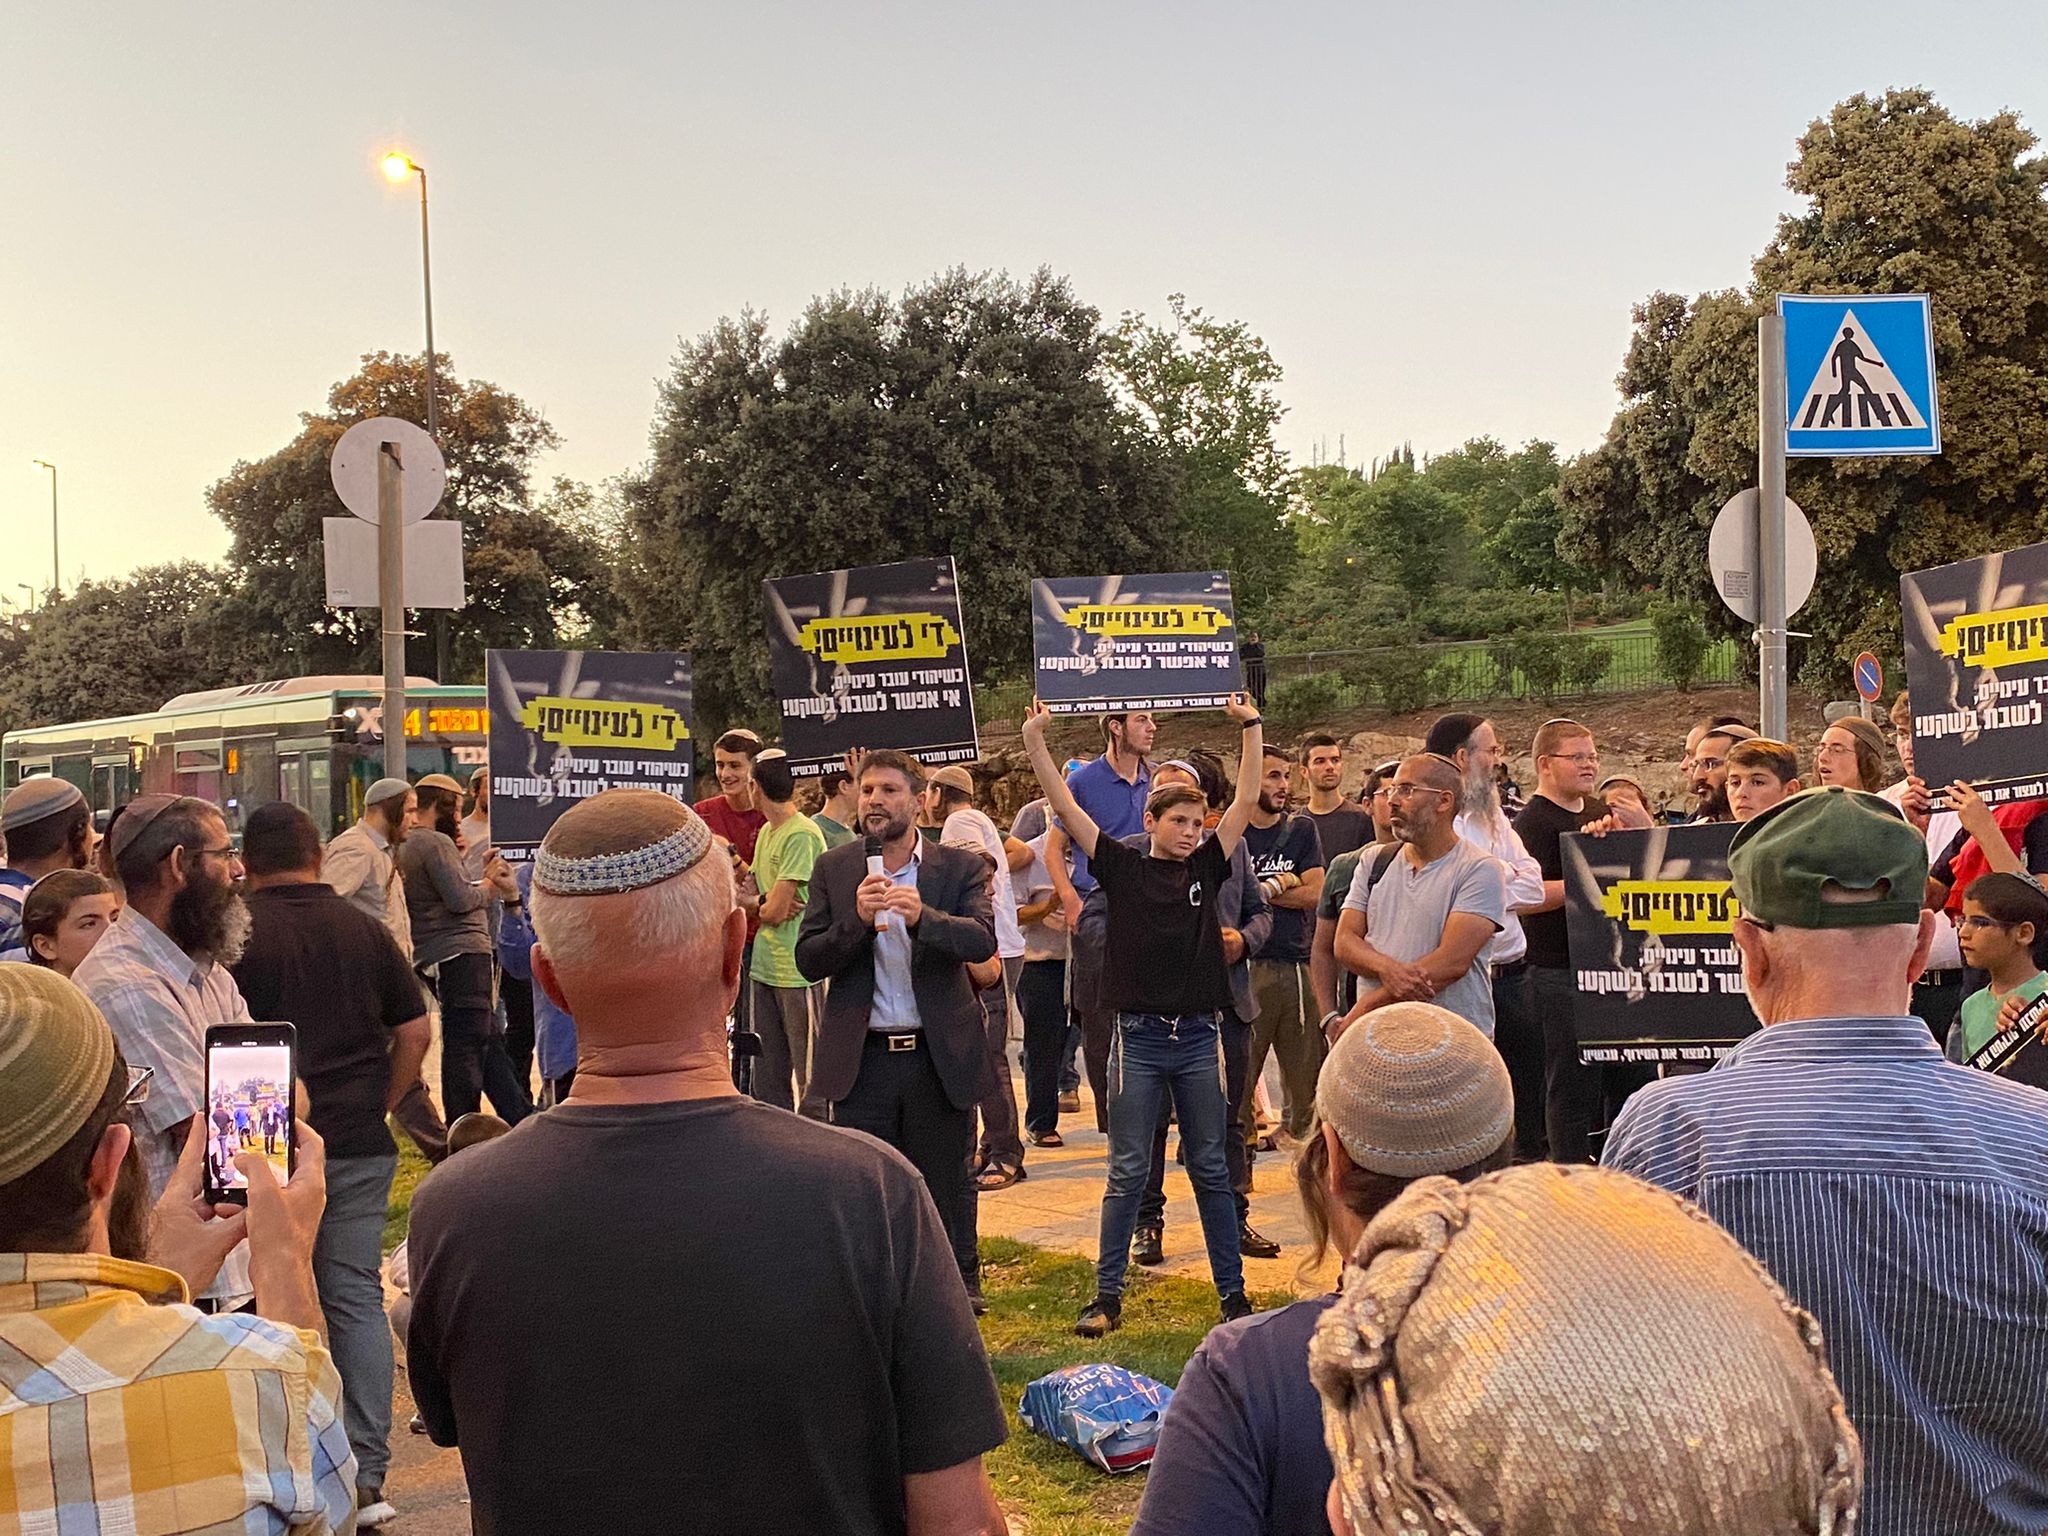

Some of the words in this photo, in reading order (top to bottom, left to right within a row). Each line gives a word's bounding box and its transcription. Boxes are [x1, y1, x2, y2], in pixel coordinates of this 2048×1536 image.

[1081, 608, 1184, 628] לעינויים!
[1192, 611, 1216, 628] די
[814, 620, 913, 654] לעינויים!
[921, 622, 944, 647] די
[1144, 642, 1177, 653] עובר
[1180, 642, 1234, 652] כשיהודי
[1040, 656, 1097, 672] בשקט!
[1101, 654, 1152, 670] לשבת
[1156, 655, 1207, 670] אפשר
[1211, 656, 1230, 669] אי
[878, 672, 910, 687] עובר
[912, 668, 964, 685] כשיהודי
[782, 697, 836, 720] בשקט!
[838, 691, 887, 713] לשבת
[891, 690, 939, 711] אפשר
[942, 690, 961, 709] אי
[538, 707, 643, 738] לעינויים!
[1915, 710, 1978, 739] בשקט!
[1983, 699, 2042, 730] לשבת
[652, 714, 676, 740] די
[602, 760, 634, 776] עובר
[637, 762, 690, 778] כשיהודי
[494, 776, 556, 799] בשקט!
[1577, 970, 1644, 996] בשקט!
[1650, 970, 1710, 994] לשבת
